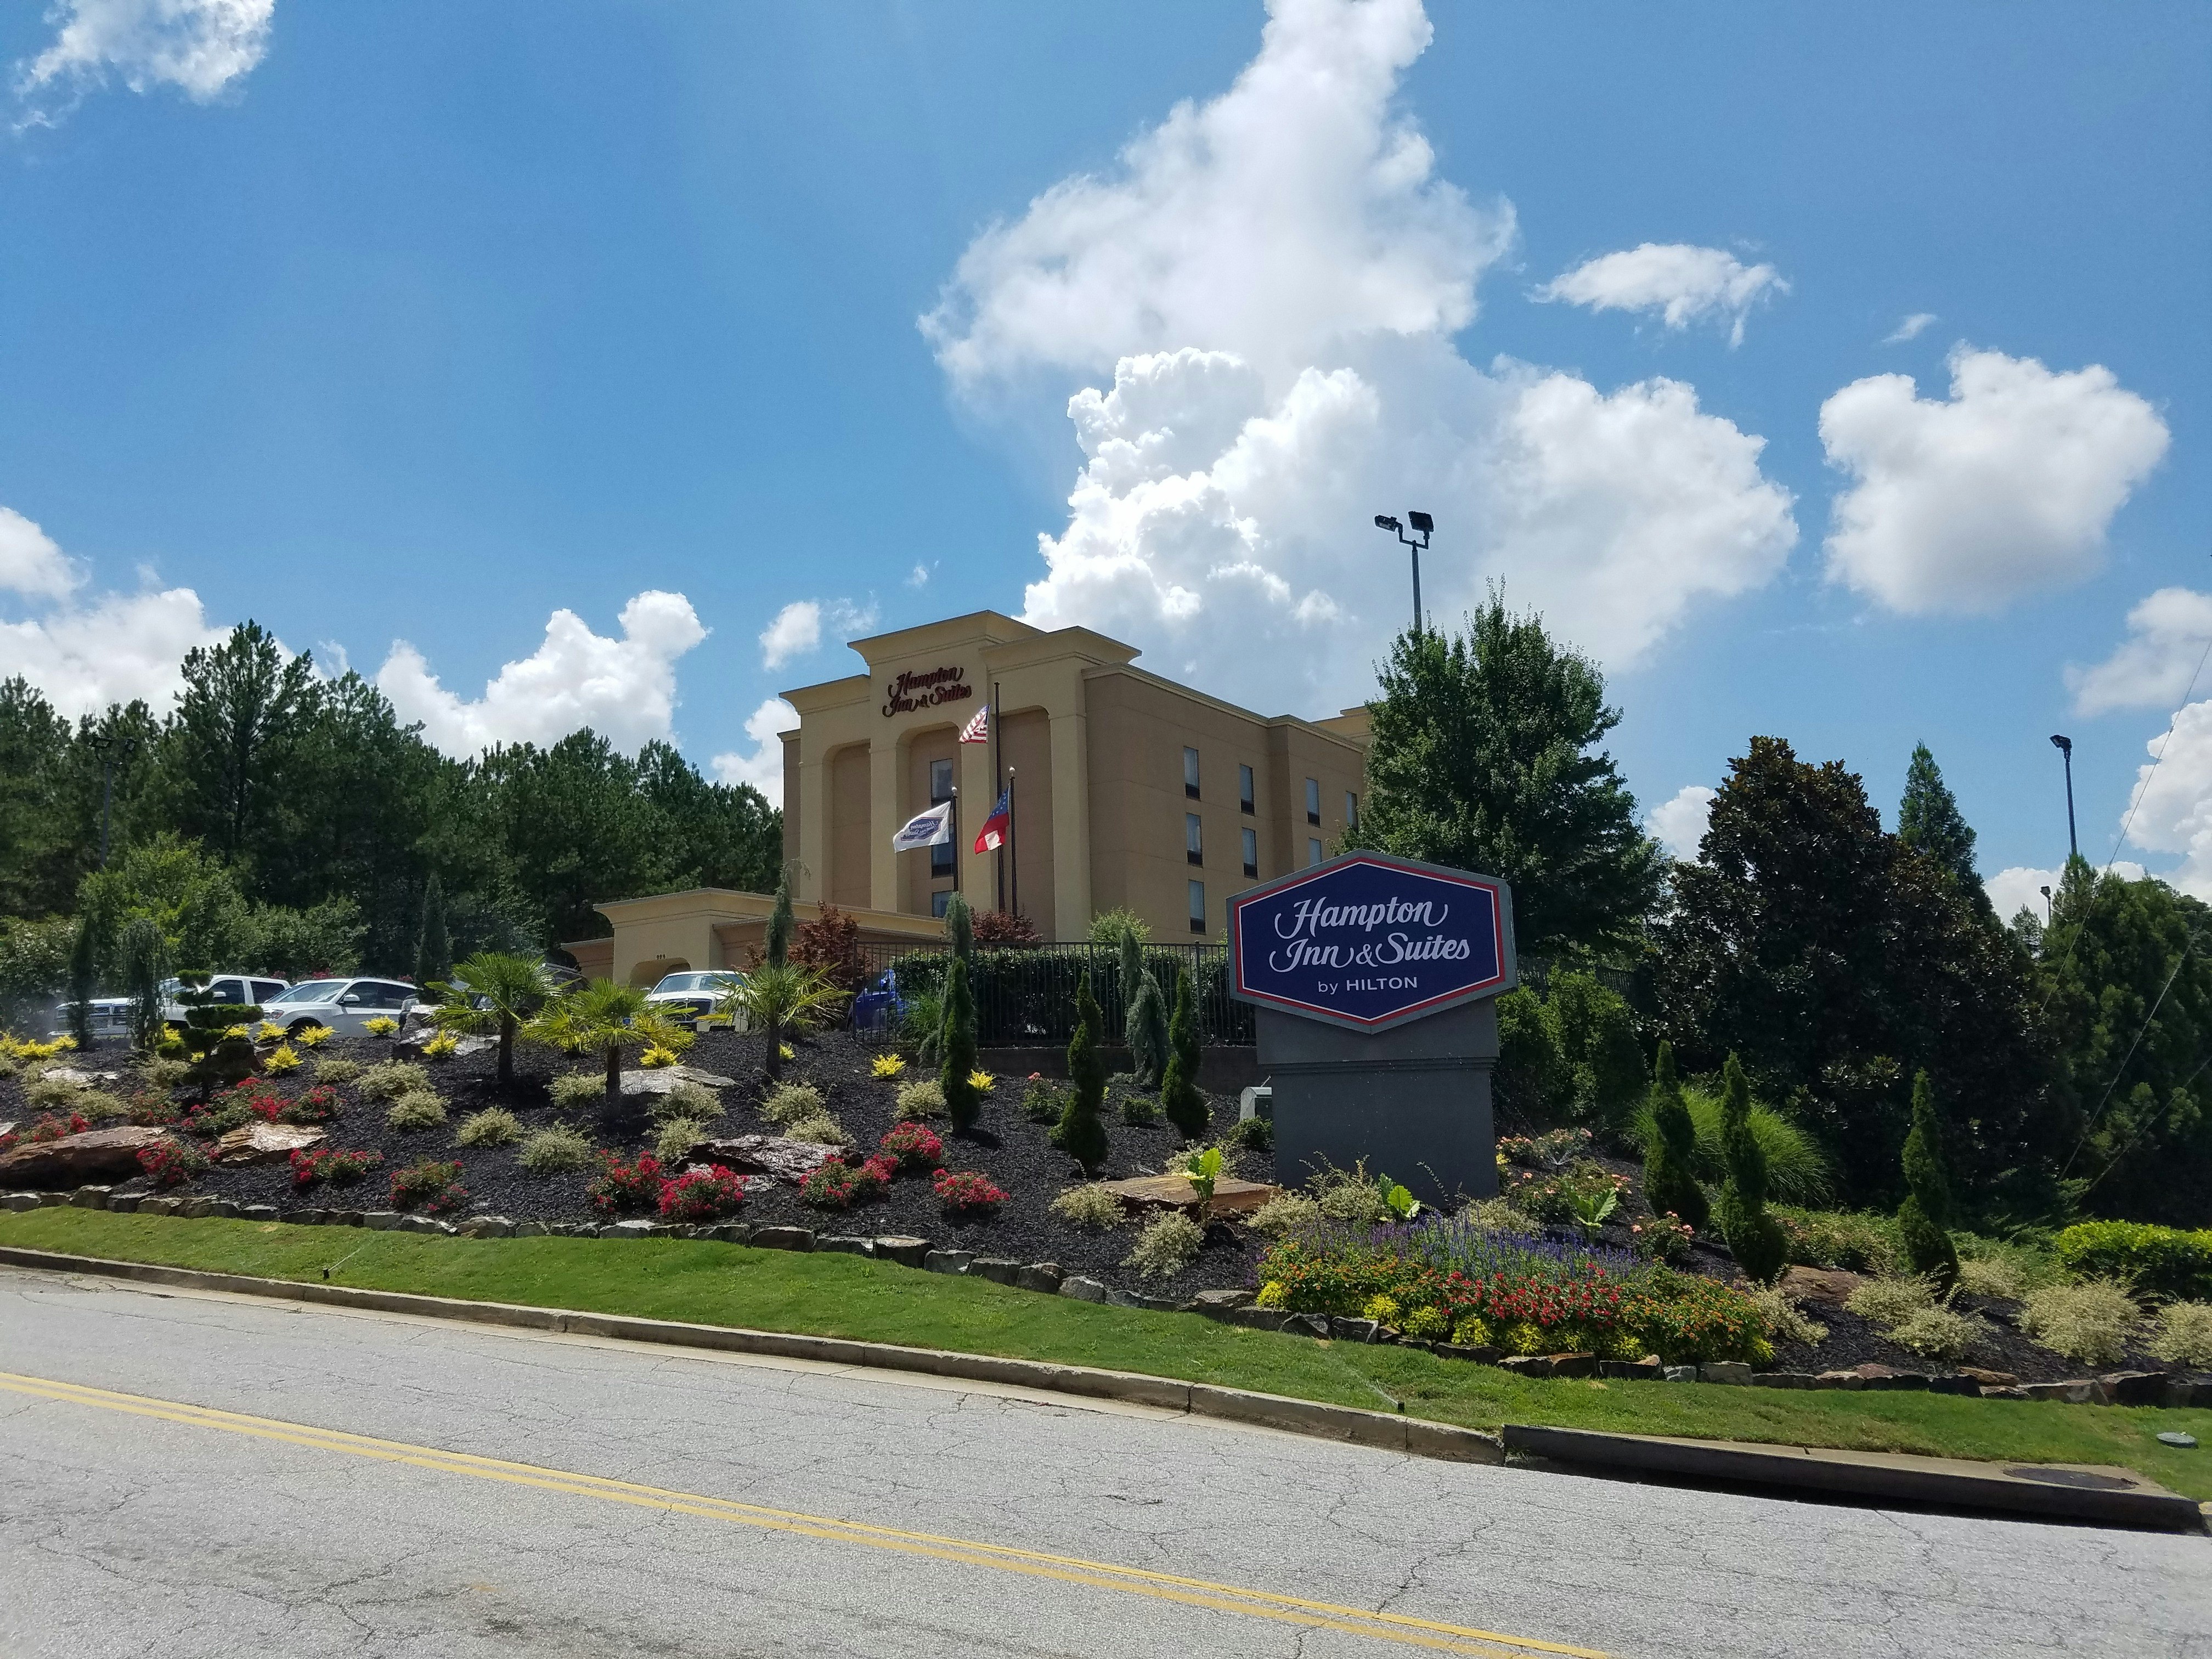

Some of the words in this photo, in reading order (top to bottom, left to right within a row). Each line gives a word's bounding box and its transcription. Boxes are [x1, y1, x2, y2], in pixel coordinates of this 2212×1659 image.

[888, 667, 964, 698] Hampton
[930, 684, 972, 705] Suites
[1275, 896, 1448, 939] Hampton
[1269, 938, 1355, 973] Inn
[1356, 944, 1379, 967] &
[1375, 933, 1470, 964] Suites
[1318, 981, 1339, 995] by
[1346, 977, 1418, 991] HILTON
